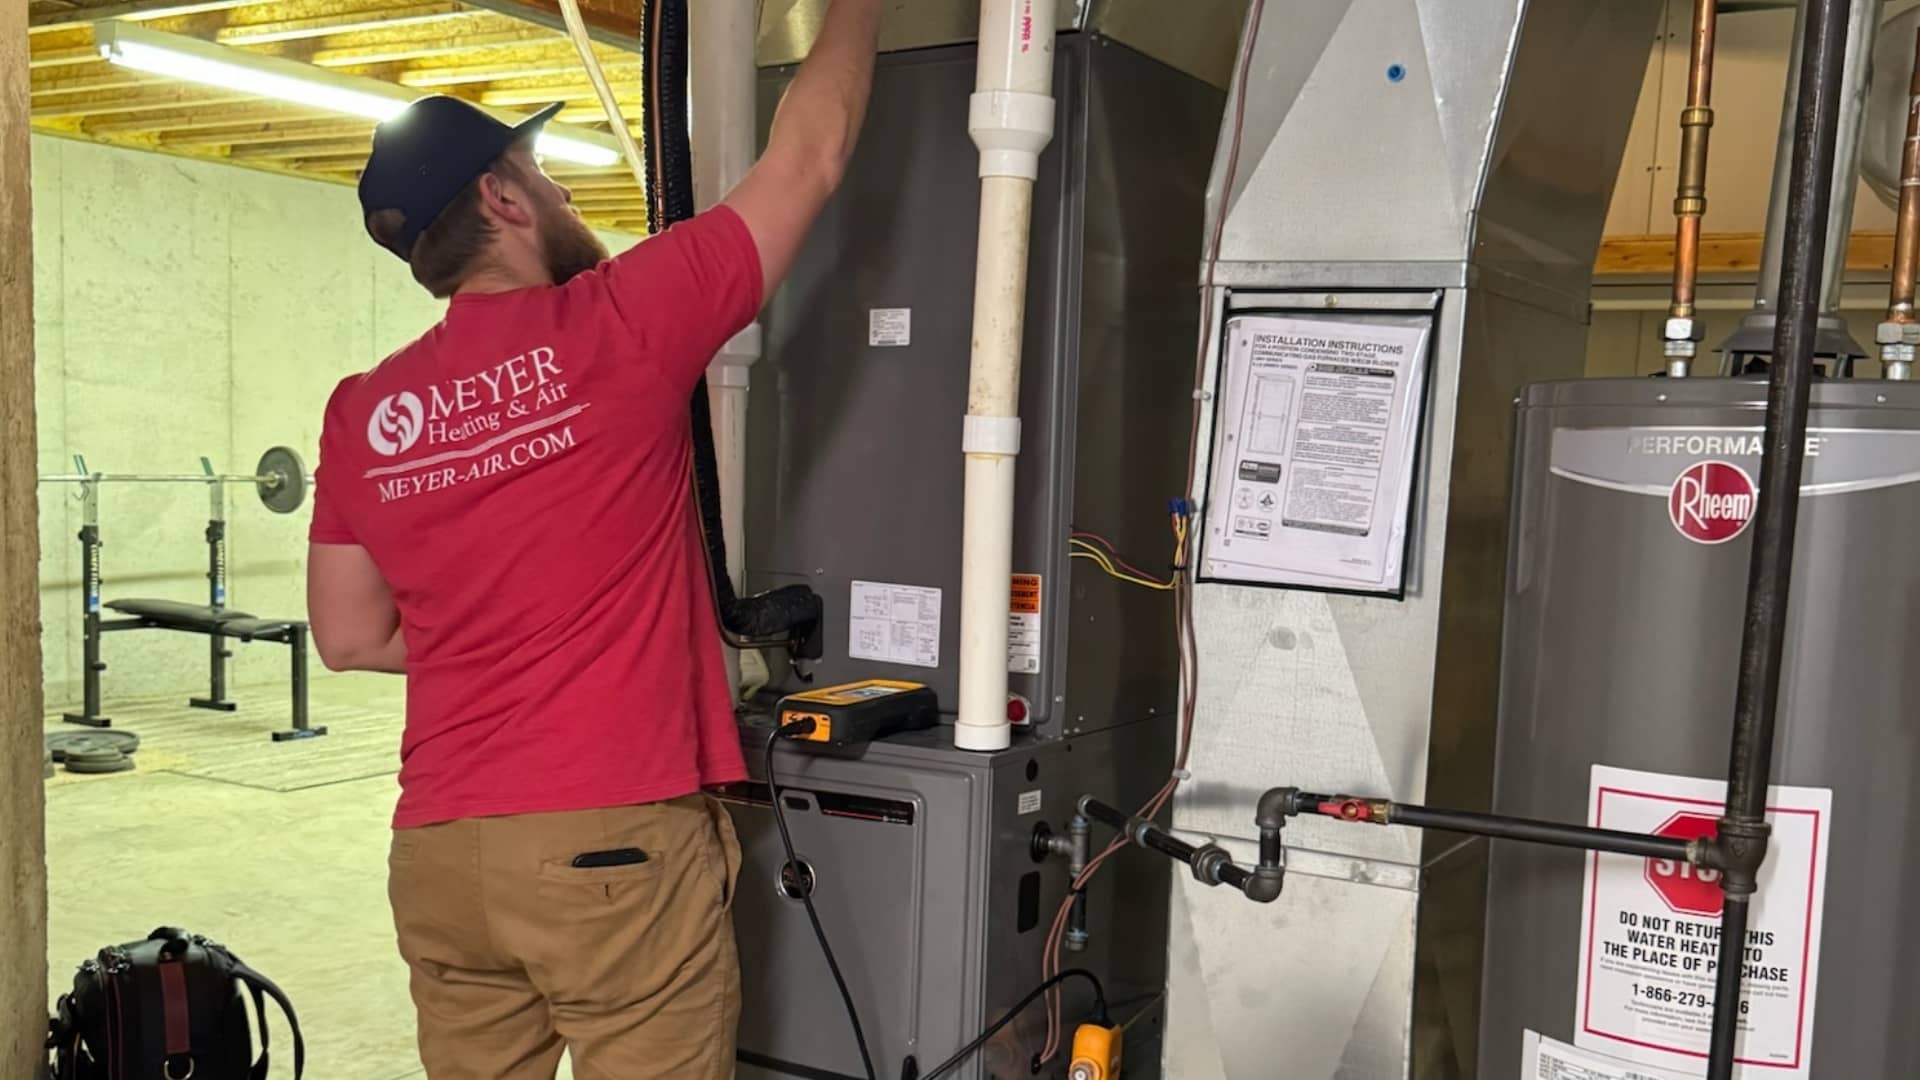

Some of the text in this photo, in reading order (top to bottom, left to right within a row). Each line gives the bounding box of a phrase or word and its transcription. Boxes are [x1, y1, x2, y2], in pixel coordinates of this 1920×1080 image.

[1255, 334, 1404, 355] INSTALLATION INSTRUCTIONS
[428, 346, 563, 420] MEYER
[428, 381, 569, 445] Heating & Air
[378, 426, 577, 503] MEYER-AIR.COM
[1628, 435, 1821, 457] PERFORMAE
[1678, 464, 1752, 530] Rheem
[1619, 911, 1775, 946] DO NOT RETUR HIS
[1627, 929, 1763, 962] WATER HEAT TO
[1603, 941, 1789, 982] THE PLACE OF PCHASE
[1631, 984, 1749, 1014] 1-866-279-6
